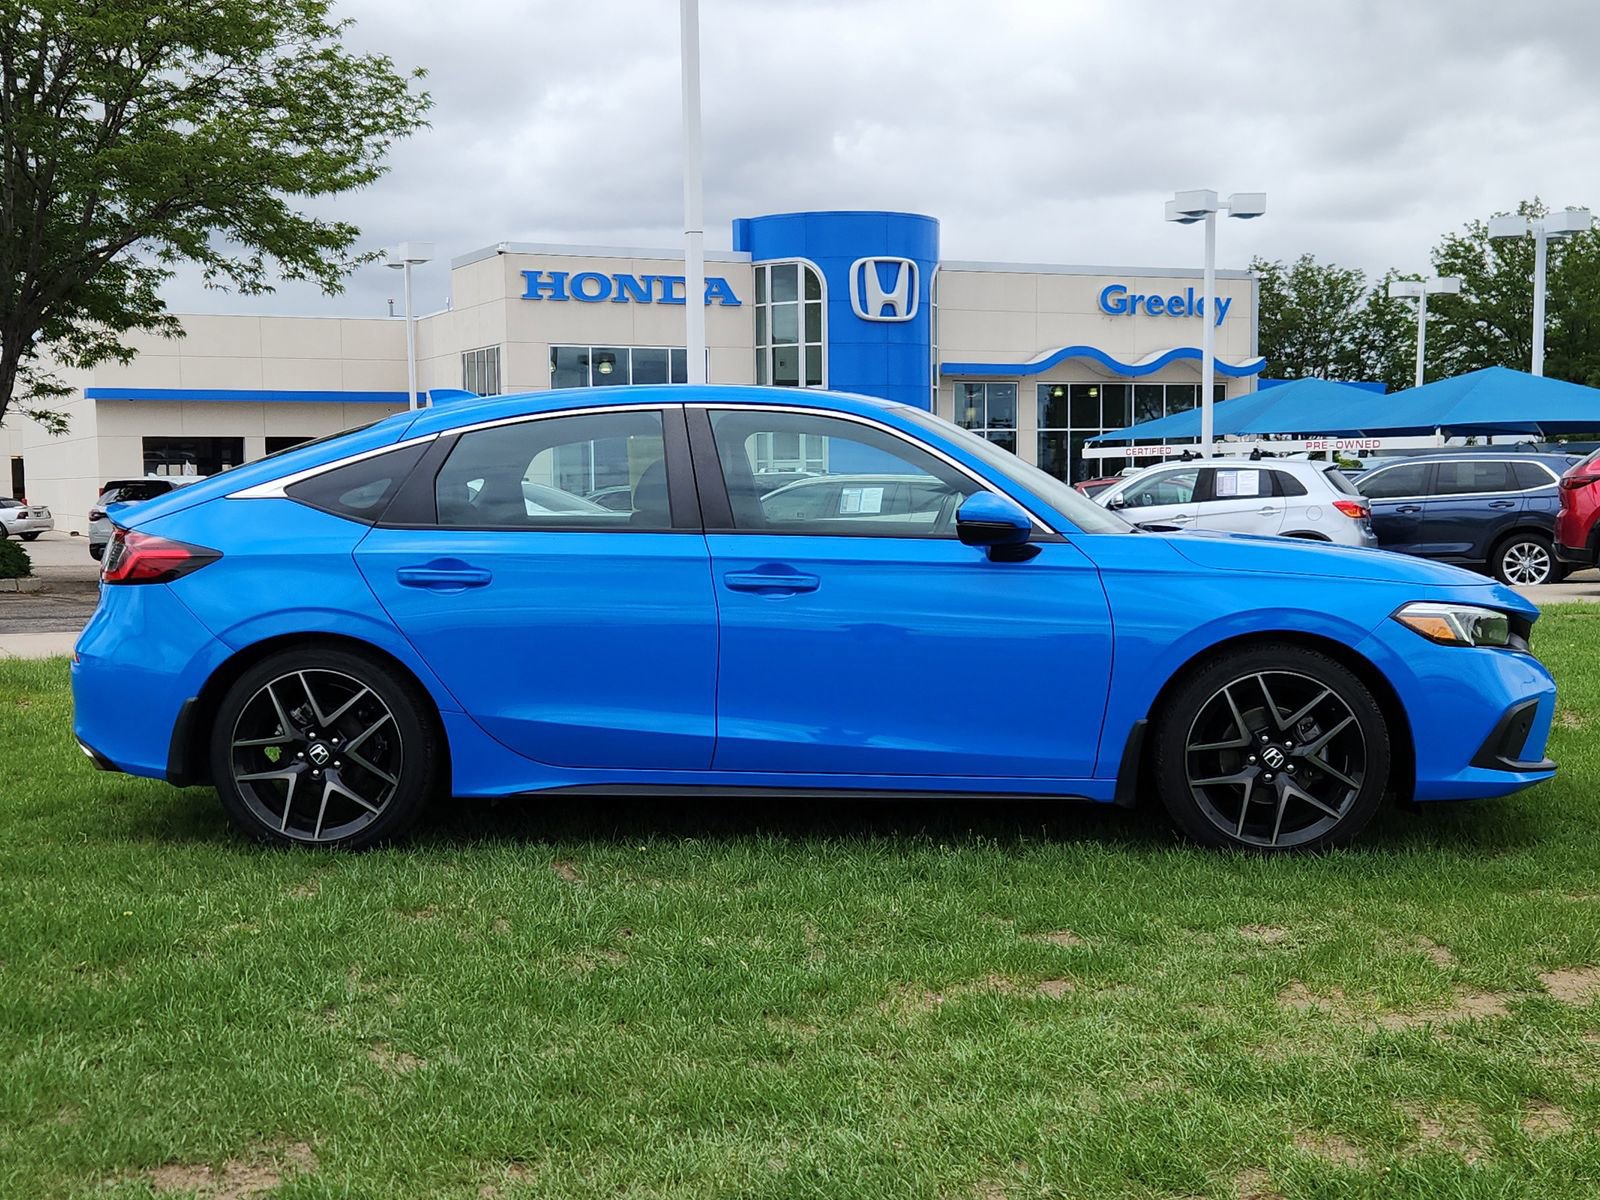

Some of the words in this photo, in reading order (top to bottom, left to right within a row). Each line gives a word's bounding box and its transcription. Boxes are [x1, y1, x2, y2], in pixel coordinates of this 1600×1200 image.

[520, 270, 742, 306] HONDA
[1126, 447, 1172, 456] CERTIFIED
[1305, 440, 1381, 450] PRE-OWNED
